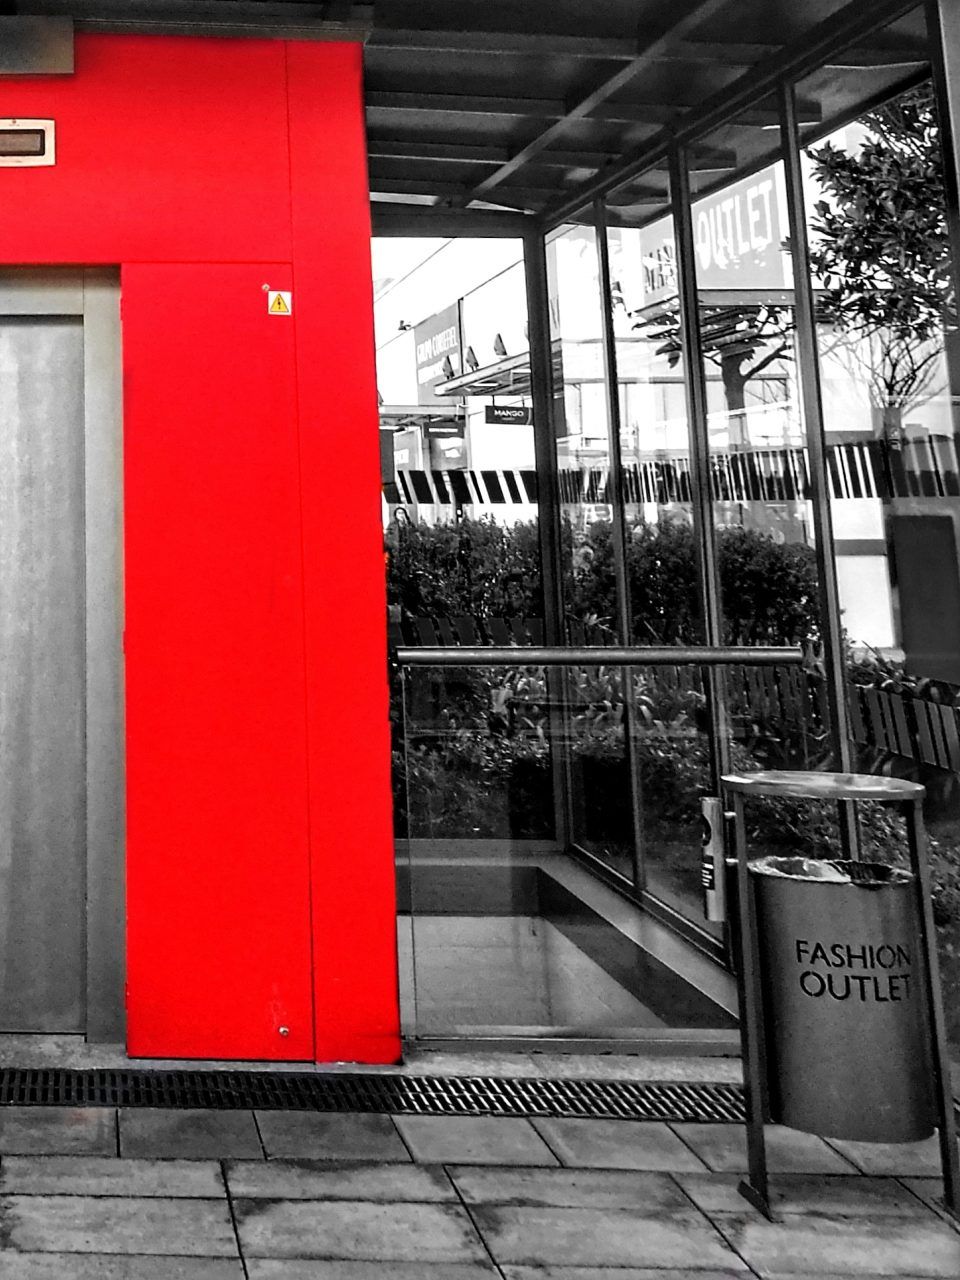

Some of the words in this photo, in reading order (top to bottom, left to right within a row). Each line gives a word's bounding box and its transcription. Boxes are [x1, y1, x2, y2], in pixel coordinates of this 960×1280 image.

[696, 179, 773, 271] OUTLET
[796, 939, 911, 969] FASHION
[800, 970, 911, 1002] OUTLET
